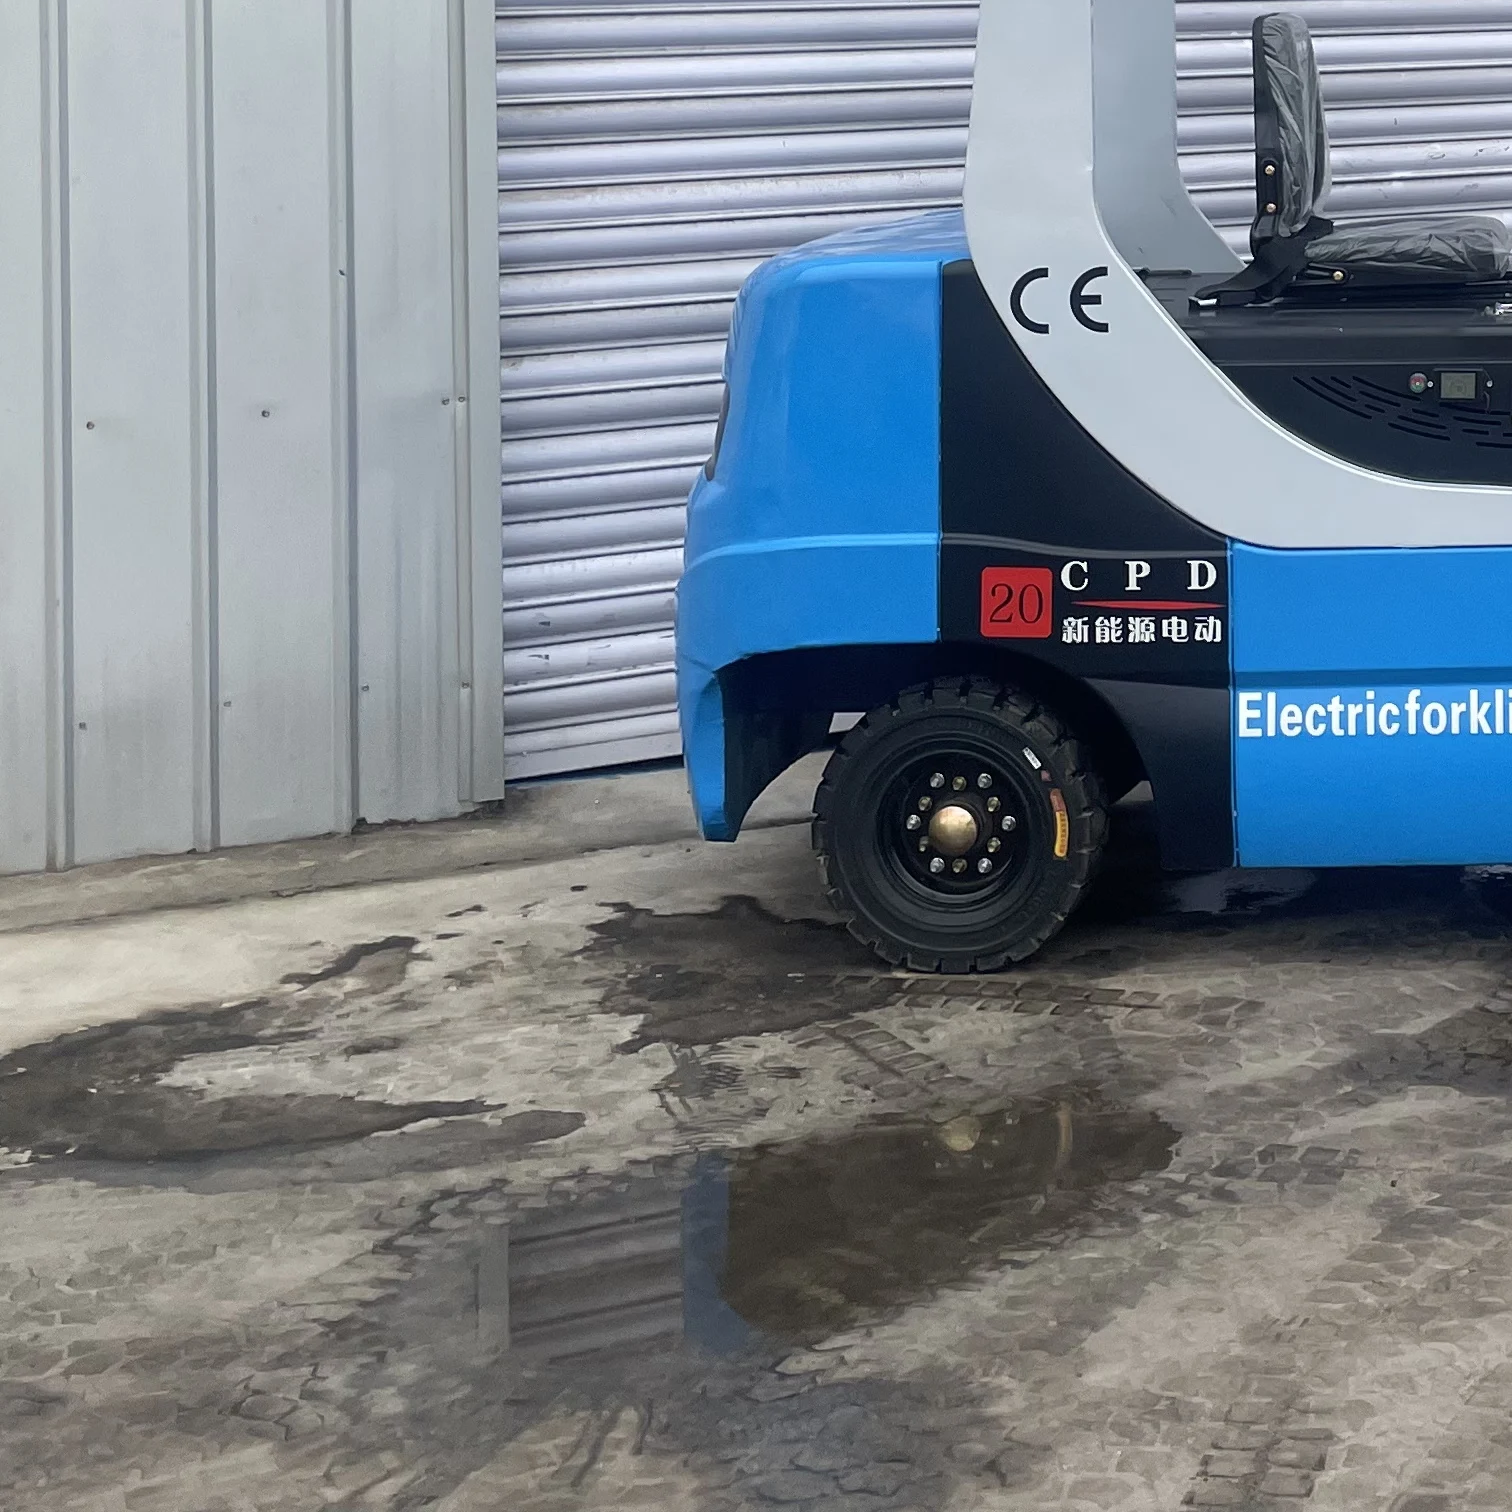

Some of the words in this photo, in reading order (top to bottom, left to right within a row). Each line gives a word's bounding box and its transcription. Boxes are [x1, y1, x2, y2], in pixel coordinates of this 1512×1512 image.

[1010, 267, 1109, 334] CE
[988, 583, 1044, 624] 20
[1061, 615, 1222, 644] 新能源电动
